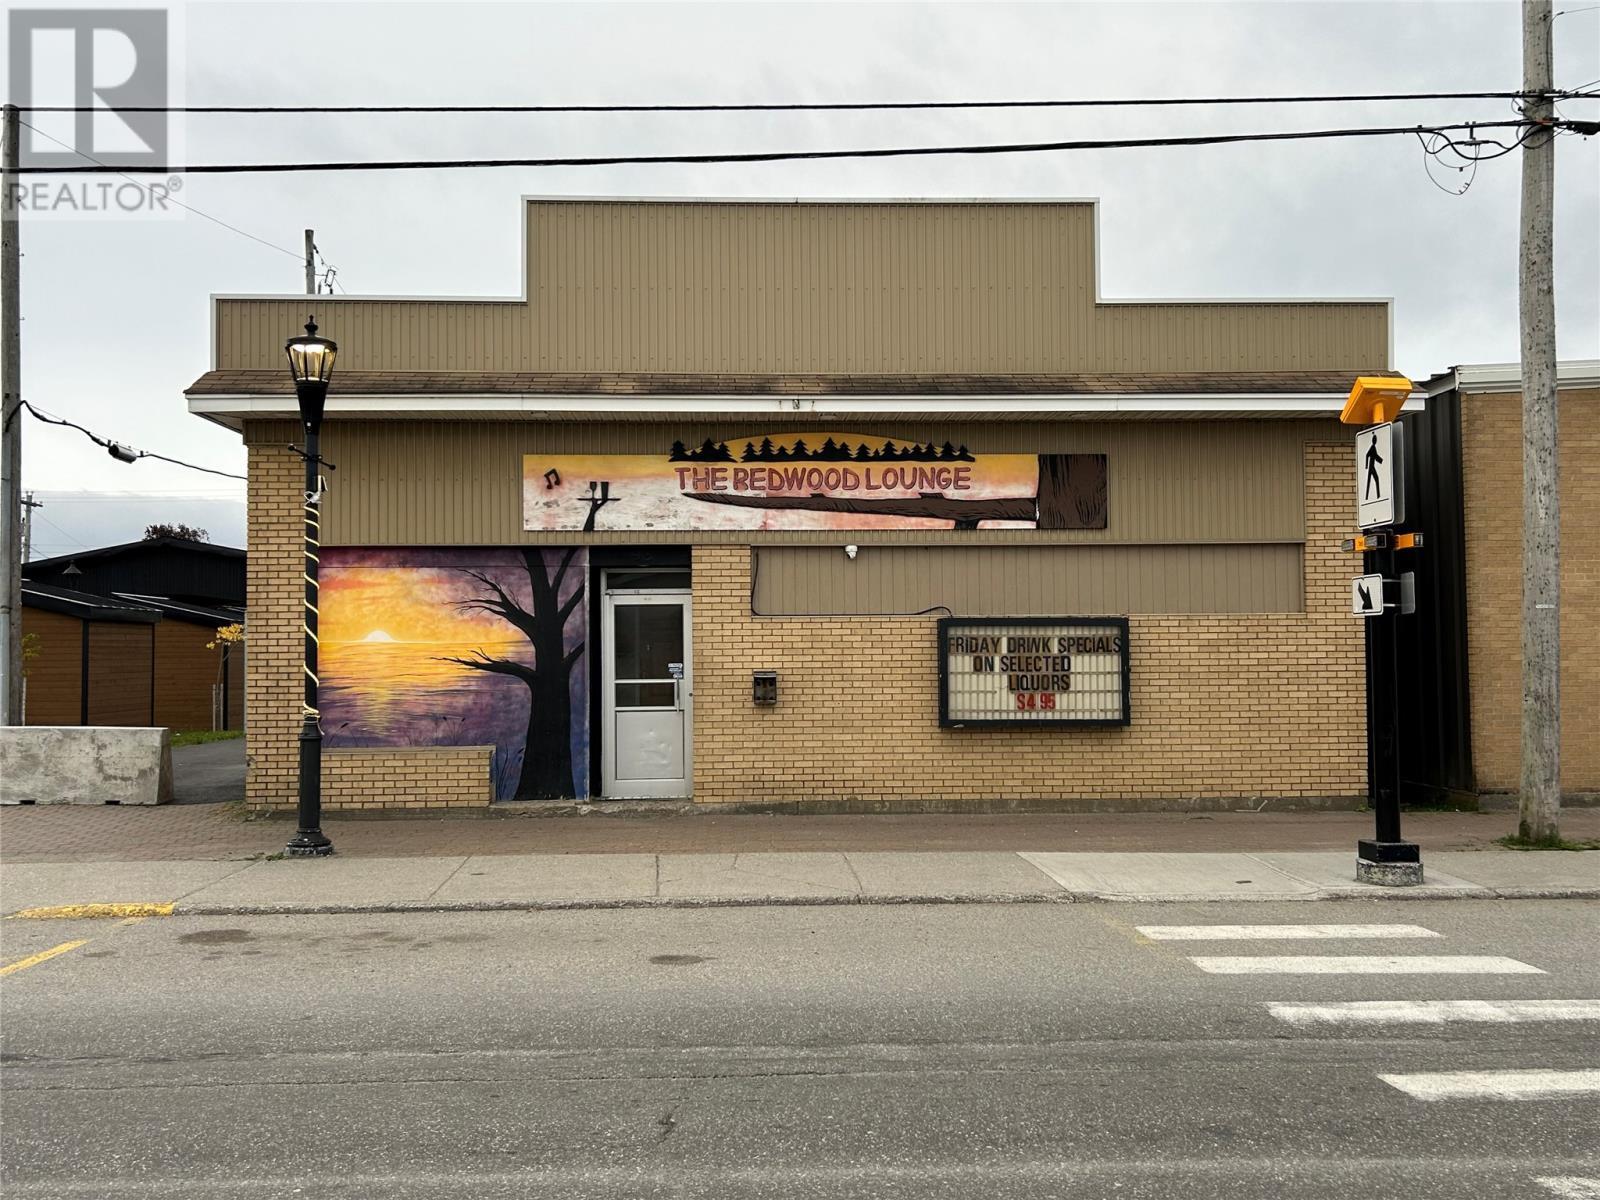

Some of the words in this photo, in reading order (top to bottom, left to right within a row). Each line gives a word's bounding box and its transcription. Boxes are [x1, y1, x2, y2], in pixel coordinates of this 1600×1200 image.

[675, 467, 727, 490] THE
[733, 467, 859, 491] REDWOOD
[866, 467, 971, 490] LOUNGE
[949, 636, 1000, 653] FRIDAY
[1007, 636, 1051, 653] DRINK
[1058, 636, 1121, 653] SPECIALS
[973, 655, 994, 672] ON
[1001, 655, 1071, 672] SELECTED
[1009, 674, 1070, 691] LIQUORS
